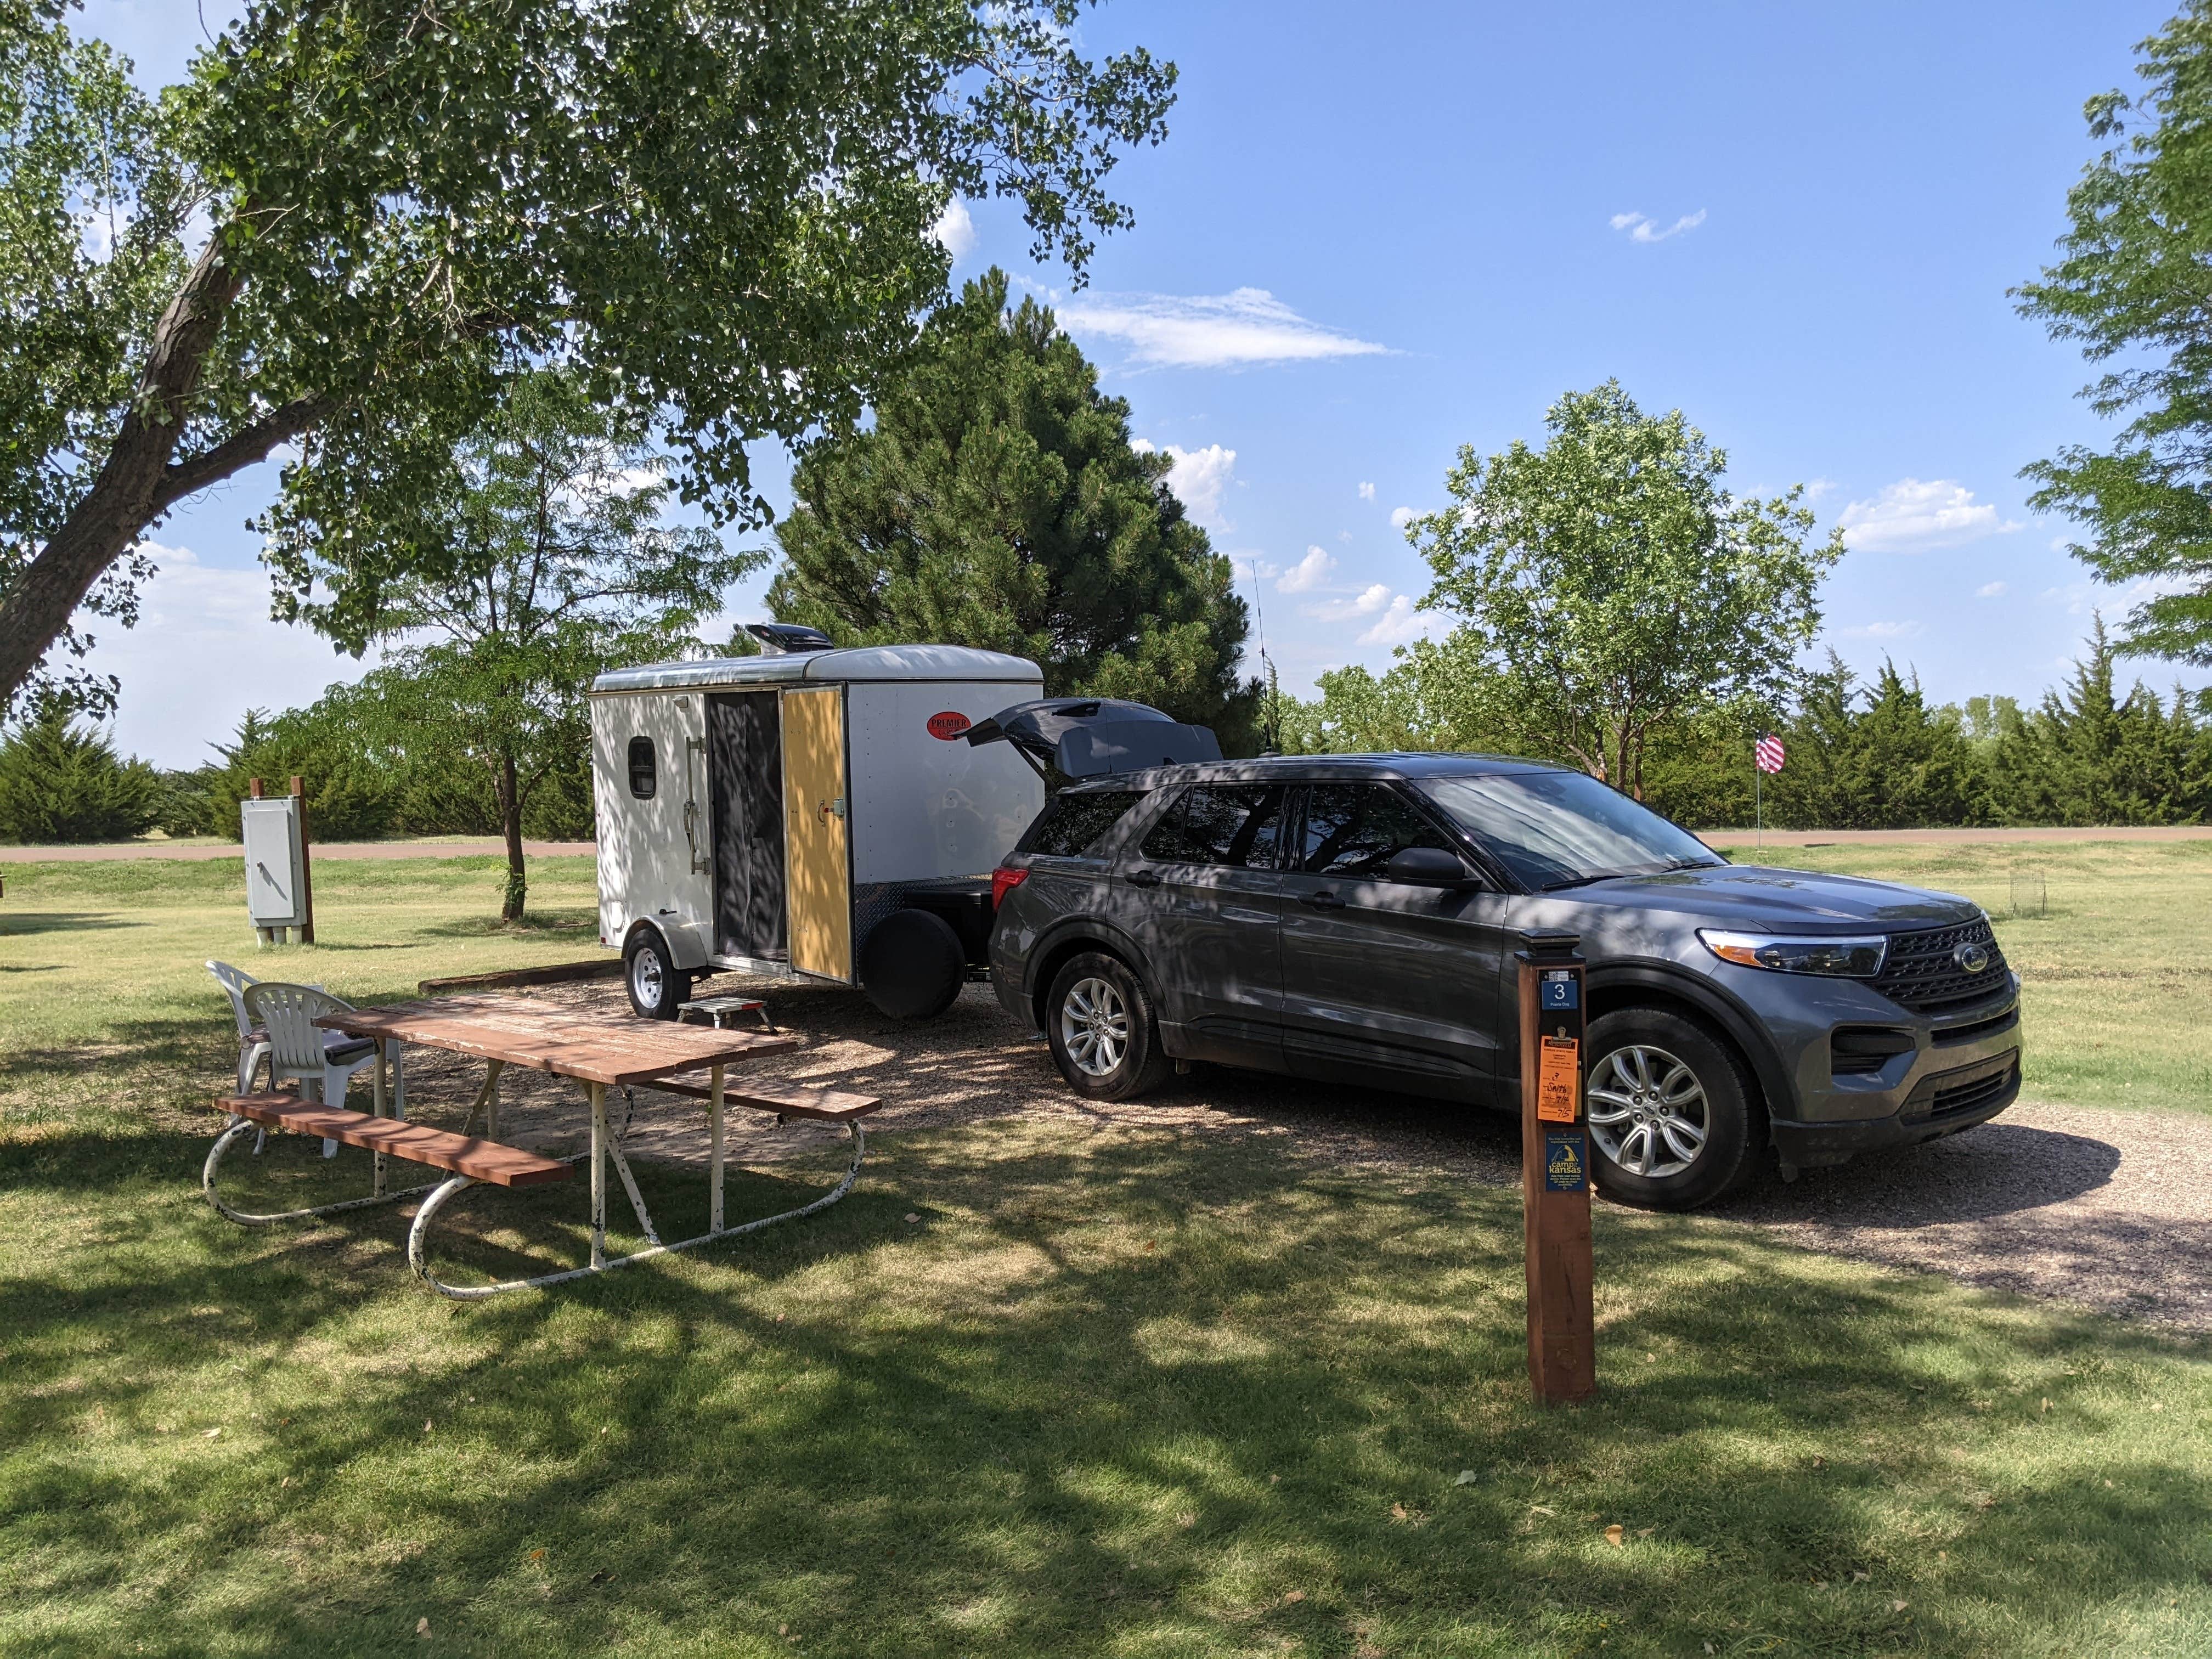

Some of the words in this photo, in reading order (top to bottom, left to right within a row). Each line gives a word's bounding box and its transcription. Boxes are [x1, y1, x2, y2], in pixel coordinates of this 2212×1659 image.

[932, 719, 967, 727] PREMIER
[1554, 984, 1565, 1000] 3
[1552, 1073, 1559, 1081] 3
[1558, 1107, 1572, 1118] 7/5
